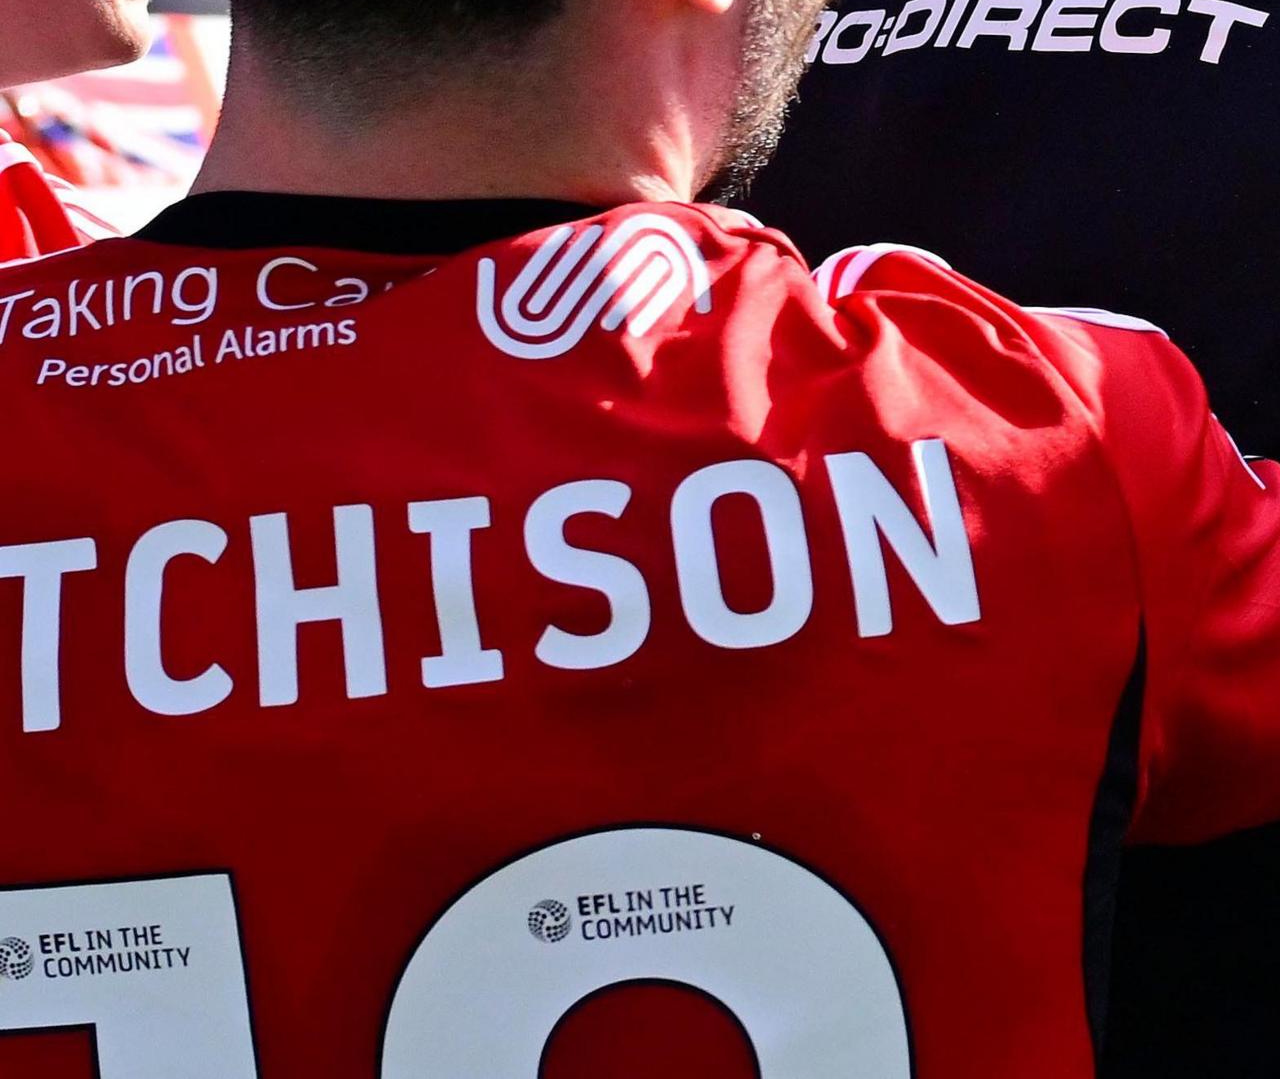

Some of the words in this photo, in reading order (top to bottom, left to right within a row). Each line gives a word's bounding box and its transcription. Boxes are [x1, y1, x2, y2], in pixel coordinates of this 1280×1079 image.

[36, 335, 204, 387] Personal
[215, 319, 357, 364] Alarms
[577, 894, 621, 916] EFL
[624, 890, 654, 912] IN
[659, 884, 706, 909] THE
[38, 932, 81, 954] EFL
[85, 929, 113, 951] IN
[118, 925, 163, 948] THE
[581, 905, 735, 941] COMMUNITY
[43, 946, 191, 979] COMMUNITY
